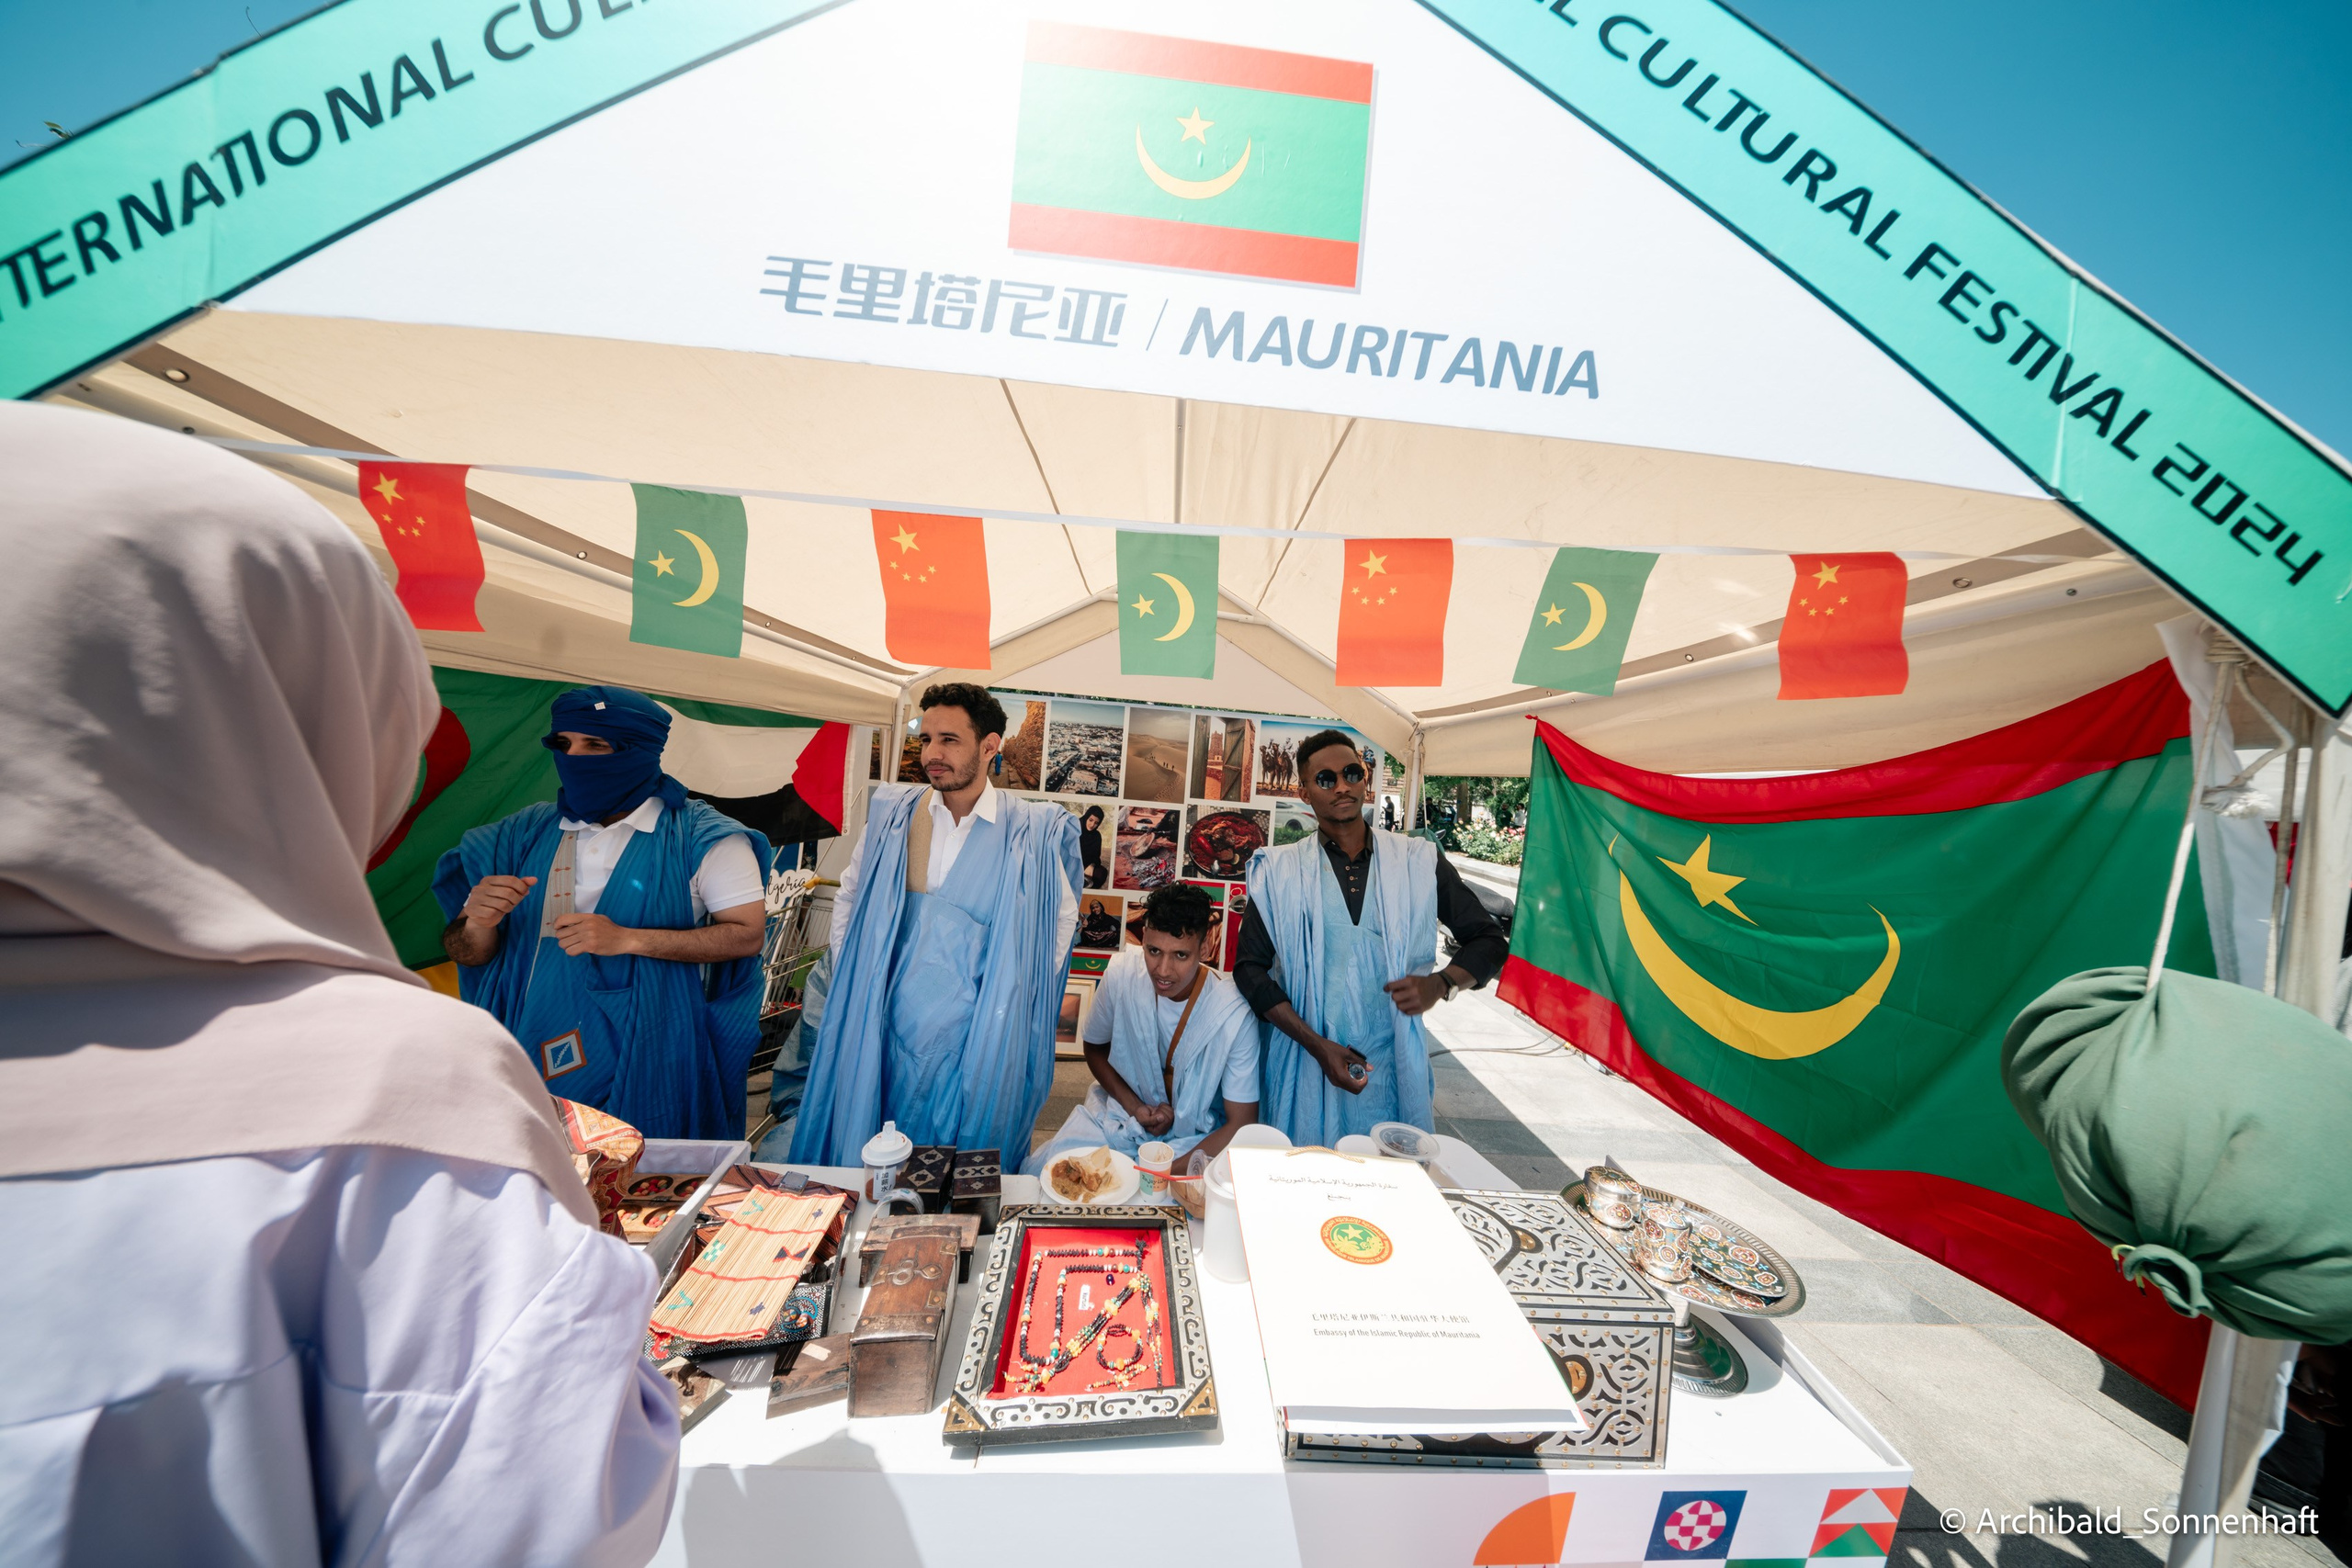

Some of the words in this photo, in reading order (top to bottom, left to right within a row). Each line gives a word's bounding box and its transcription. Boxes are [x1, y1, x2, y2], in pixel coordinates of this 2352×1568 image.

[0, 39, 474, 322] TERNATIONAL
[759, 255, 1126, 347] 毛里塔尼亚
[1599, 16, 1901, 261] CULTURAL
[1904, 243, 2152, 461] FESTIVAL
[2152, 443, 2324, 586] 2024
[1180, 307, 1600, 400] MAURITANIA
[764, 875, 806, 905] lgeria
[1314, 1328, 1347, 1337] Embassy
[1370, 1329, 1397, 1337] Islamic
[1397, 1329, 1430, 1339] Republic
[1431, 1330, 1440, 1338] of
[1440, 1330, 1481, 1339] Mauritania
